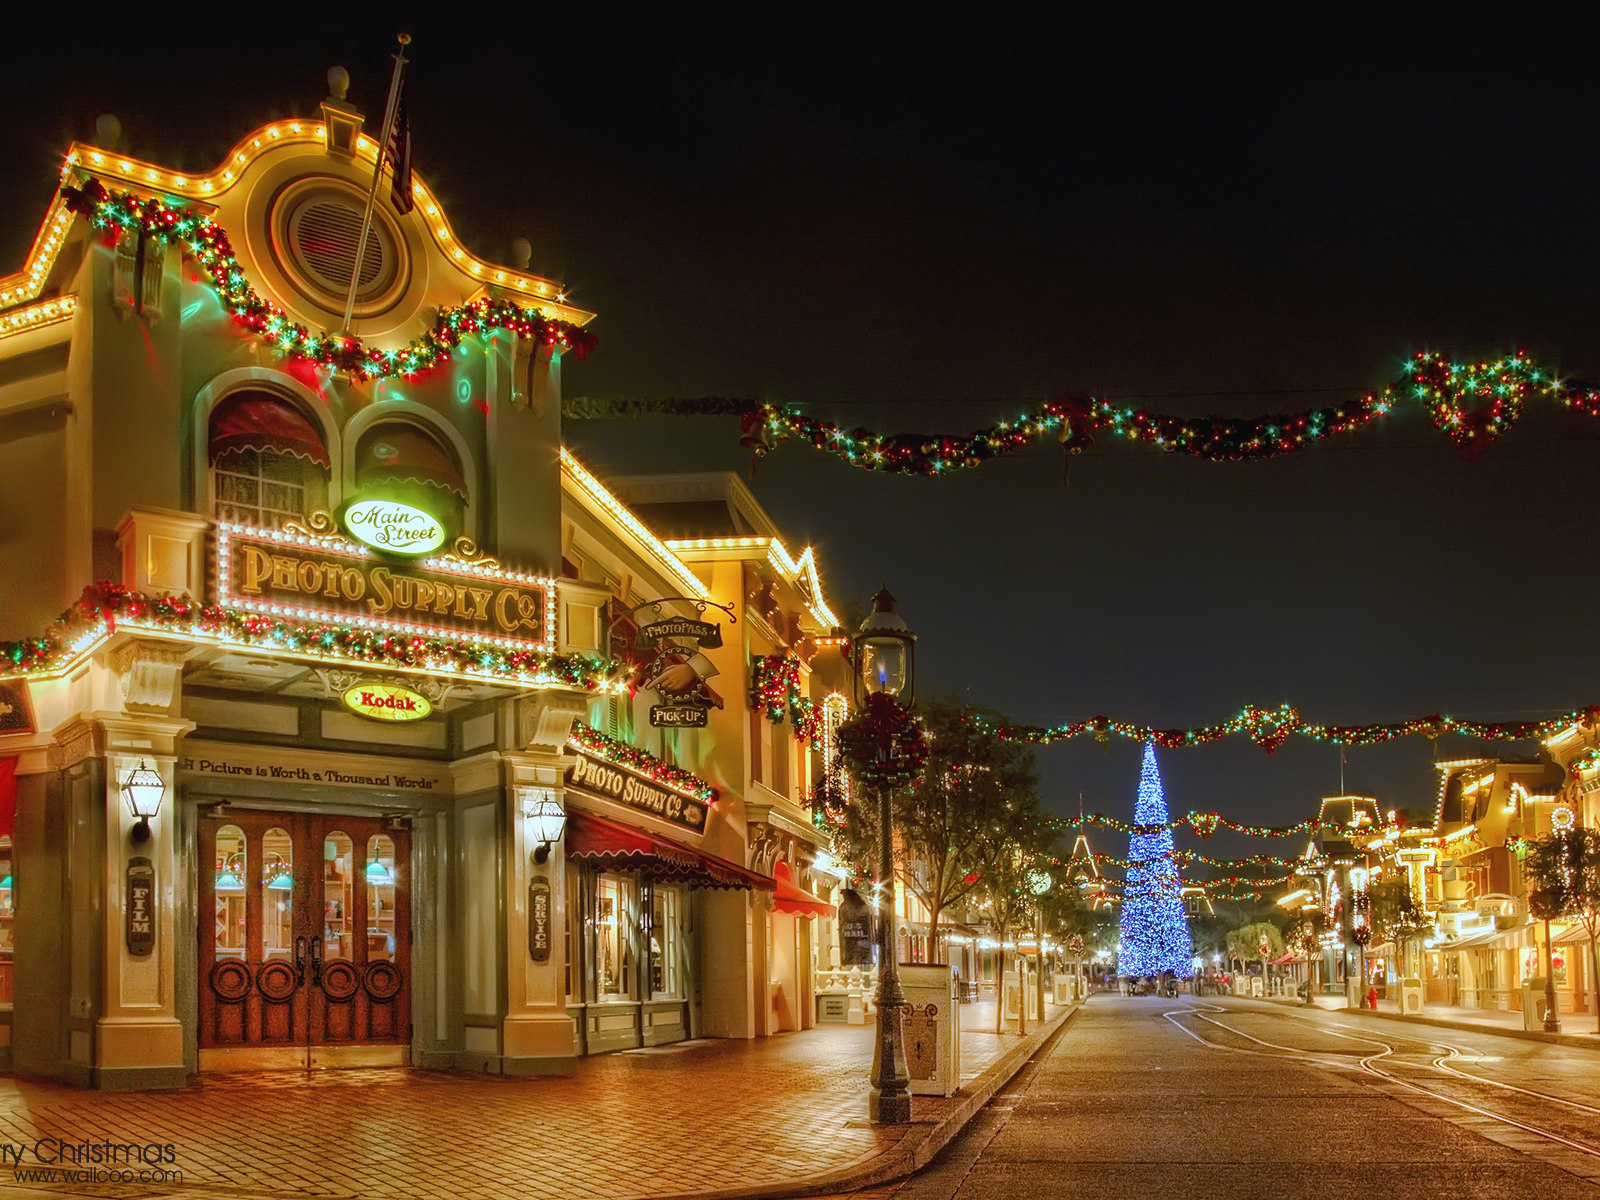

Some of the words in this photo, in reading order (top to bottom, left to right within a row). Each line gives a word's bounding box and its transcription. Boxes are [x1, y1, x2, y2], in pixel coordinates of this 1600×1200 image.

[351, 506, 425, 529] Main
[376, 524, 436, 548] Street
[242, 545, 366, 601] PHOTO
[366, 566, 493, 621] SUPPLY
[646, 623, 708, 638] PHOTOPASS
[361, 691, 416, 711] Kodak
[656, 710, 701, 722] PICK-UP
[199, 760, 252, 777] Picture
[256, 765, 267, 777] is
[269, 766, 311, 781] Worth
[312, 771, 323, 782] a
[324, 769, 391, 787] Thousand
[572, 754, 623, 794] PHOTO
[622, 776, 668, 812] SUPPLY
[132, 888, 150, 933] FILM
[535, 895, 547, 949] SERVICE
